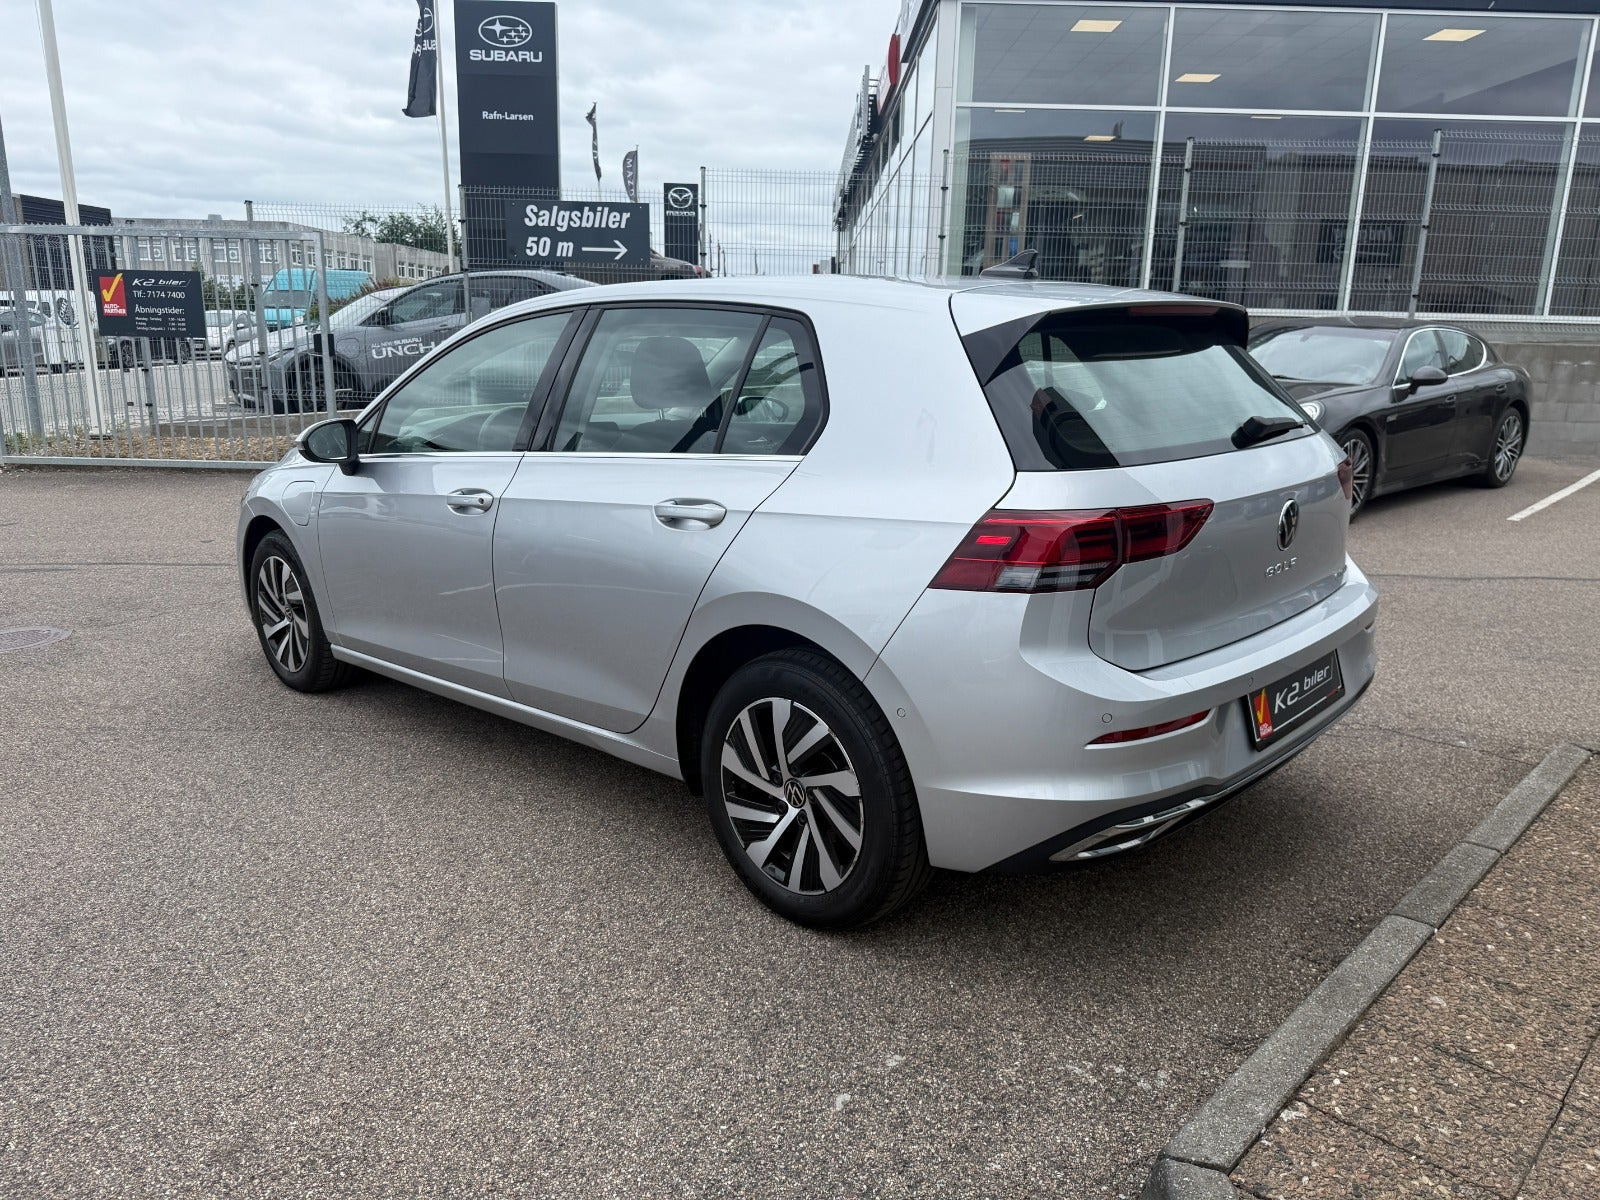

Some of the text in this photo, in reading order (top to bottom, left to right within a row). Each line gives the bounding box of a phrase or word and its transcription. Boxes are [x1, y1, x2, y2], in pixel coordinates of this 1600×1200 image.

[469, 49, 543, 63] SUBARU
[482, 110, 534, 121] Rafn-Larsen
[524, 204, 631, 232] Salgsbiler
[525, 236, 574, 257] 50 m
[132, 278, 155, 287] K2
[147, 290, 166, 299] 7174
[167, 291, 186, 299] 7400
[135, 304, 185, 315] Åbningstider:
[394, 336, 422, 345] SUBARU
[371, 341, 436, 359] UNCH
[1265, 557, 1297, 577] GOLF
[1274, 665, 1330, 714] K2 biler
